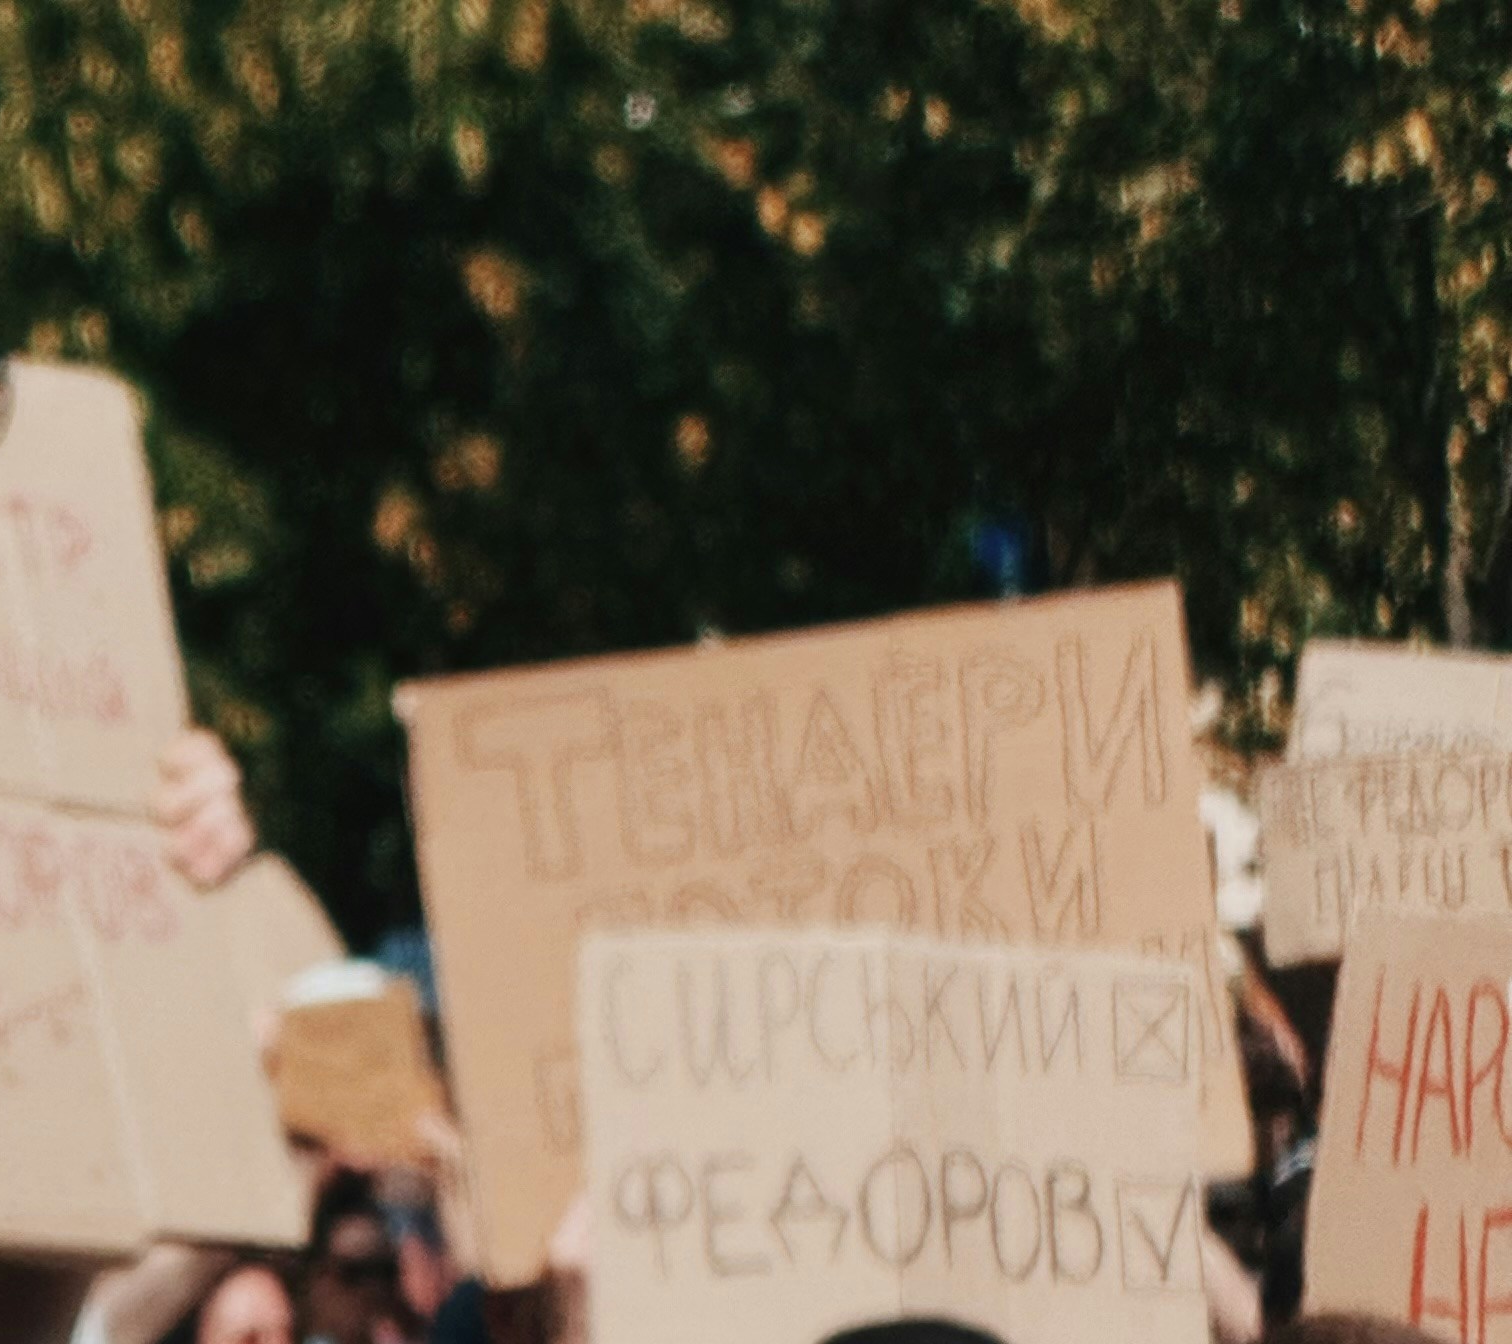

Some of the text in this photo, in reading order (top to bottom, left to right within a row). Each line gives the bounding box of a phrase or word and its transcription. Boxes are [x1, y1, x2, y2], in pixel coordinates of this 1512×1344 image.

[454, 630, 1168, 885] ТЕНДЕРИ
[1354, 962, 1512, 1168] НАР
[613, 1132, 1105, 1283] ФЕДОРОВ
